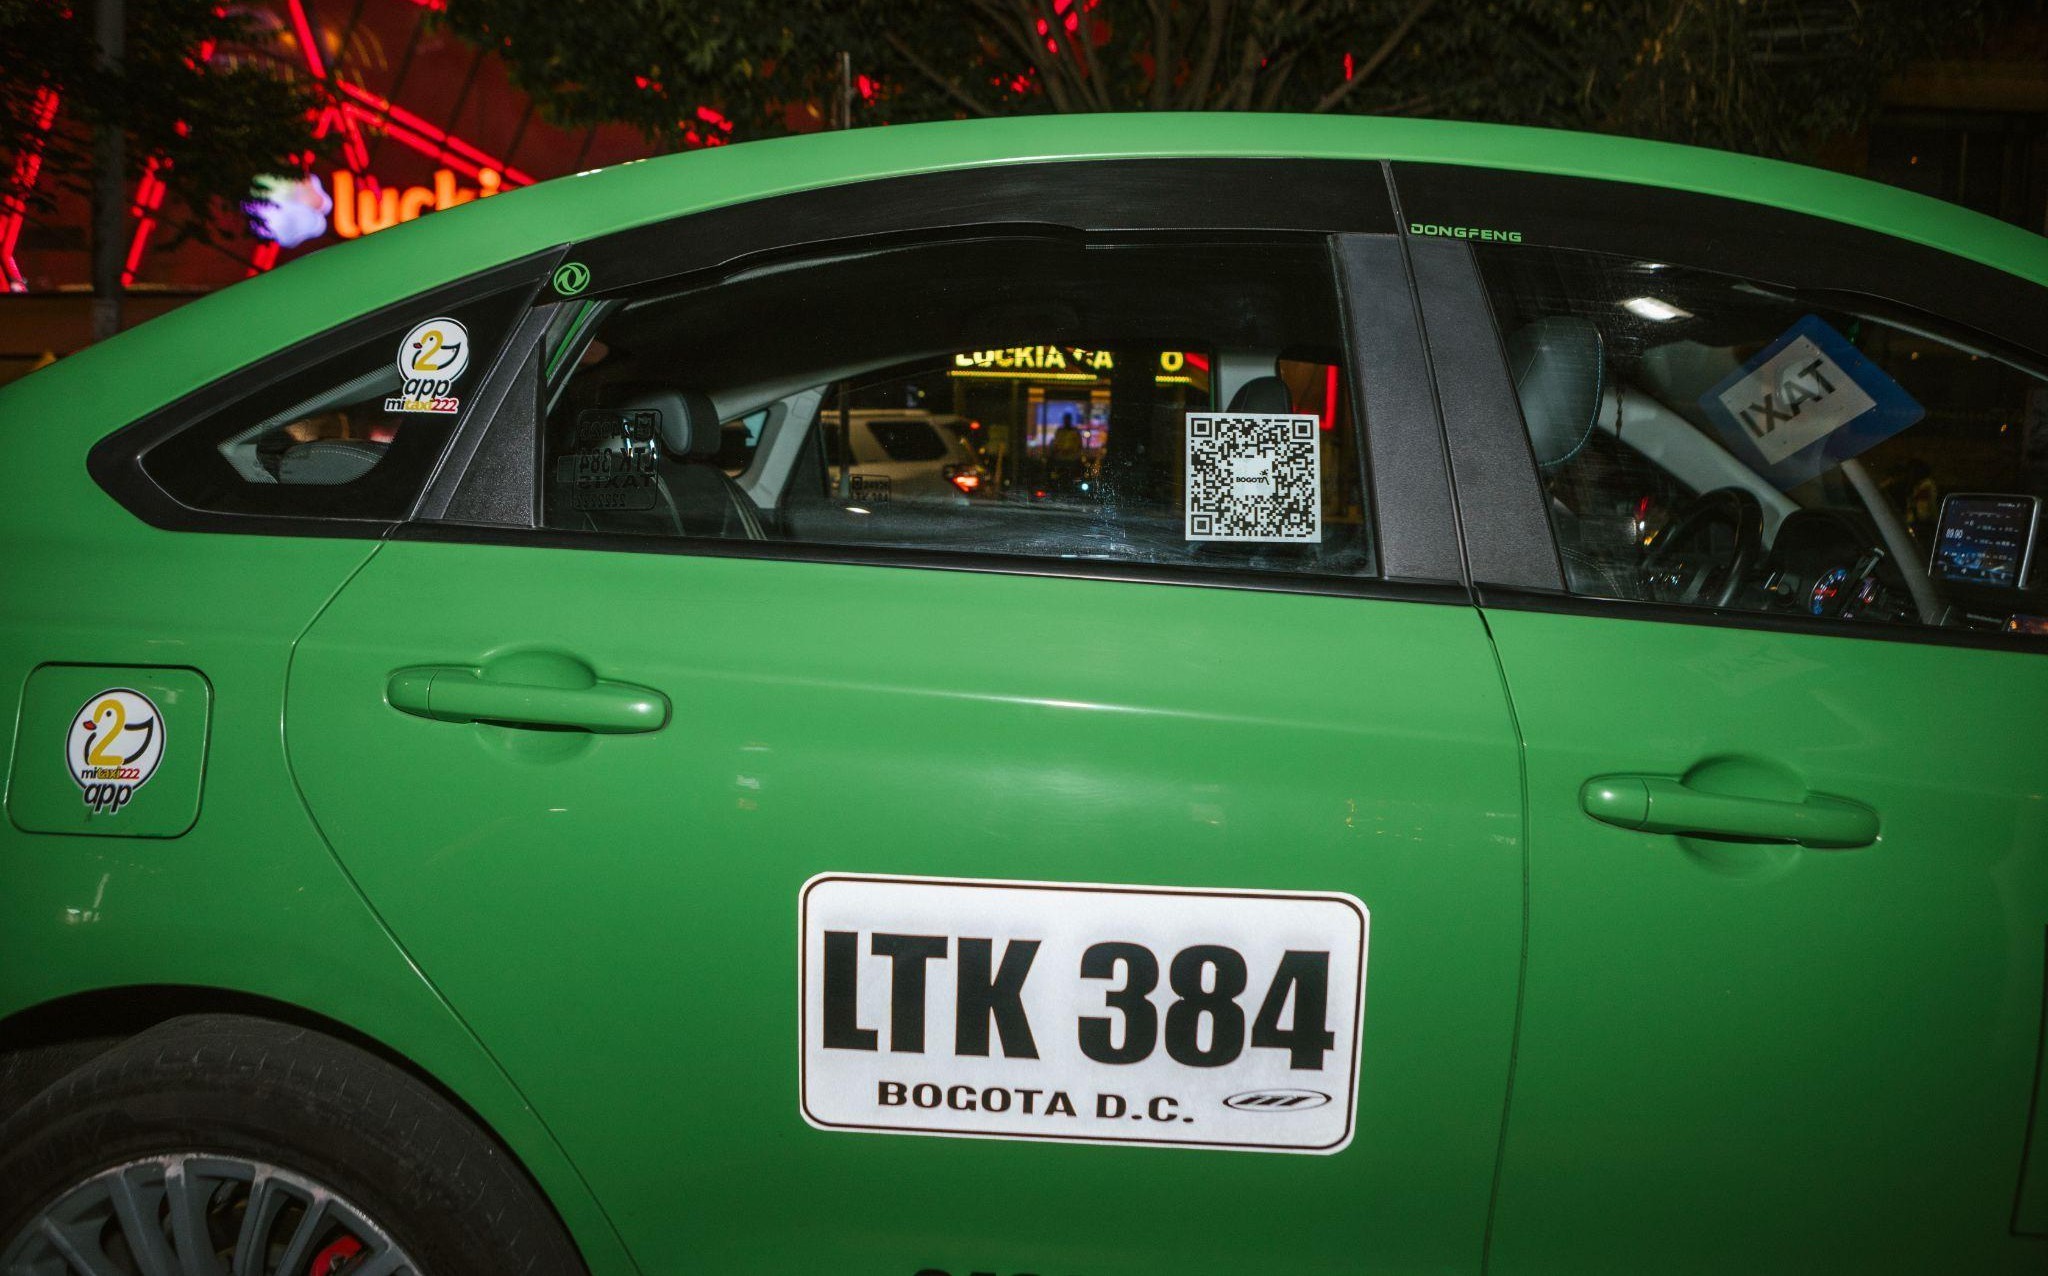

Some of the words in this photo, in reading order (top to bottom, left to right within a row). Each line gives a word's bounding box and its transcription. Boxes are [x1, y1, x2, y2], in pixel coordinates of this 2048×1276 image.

[1410, 223, 1522, 243] DONGFENG
[404, 378, 450, 402] app
[83, 782, 133, 813] app
[822, 930, 1042, 1060] LTK
[1077, 941, 1335, 1071] 384
[877, 1080, 1078, 1118] BOGOTA
[1096, 1092, 1195, 1123] D.C.
